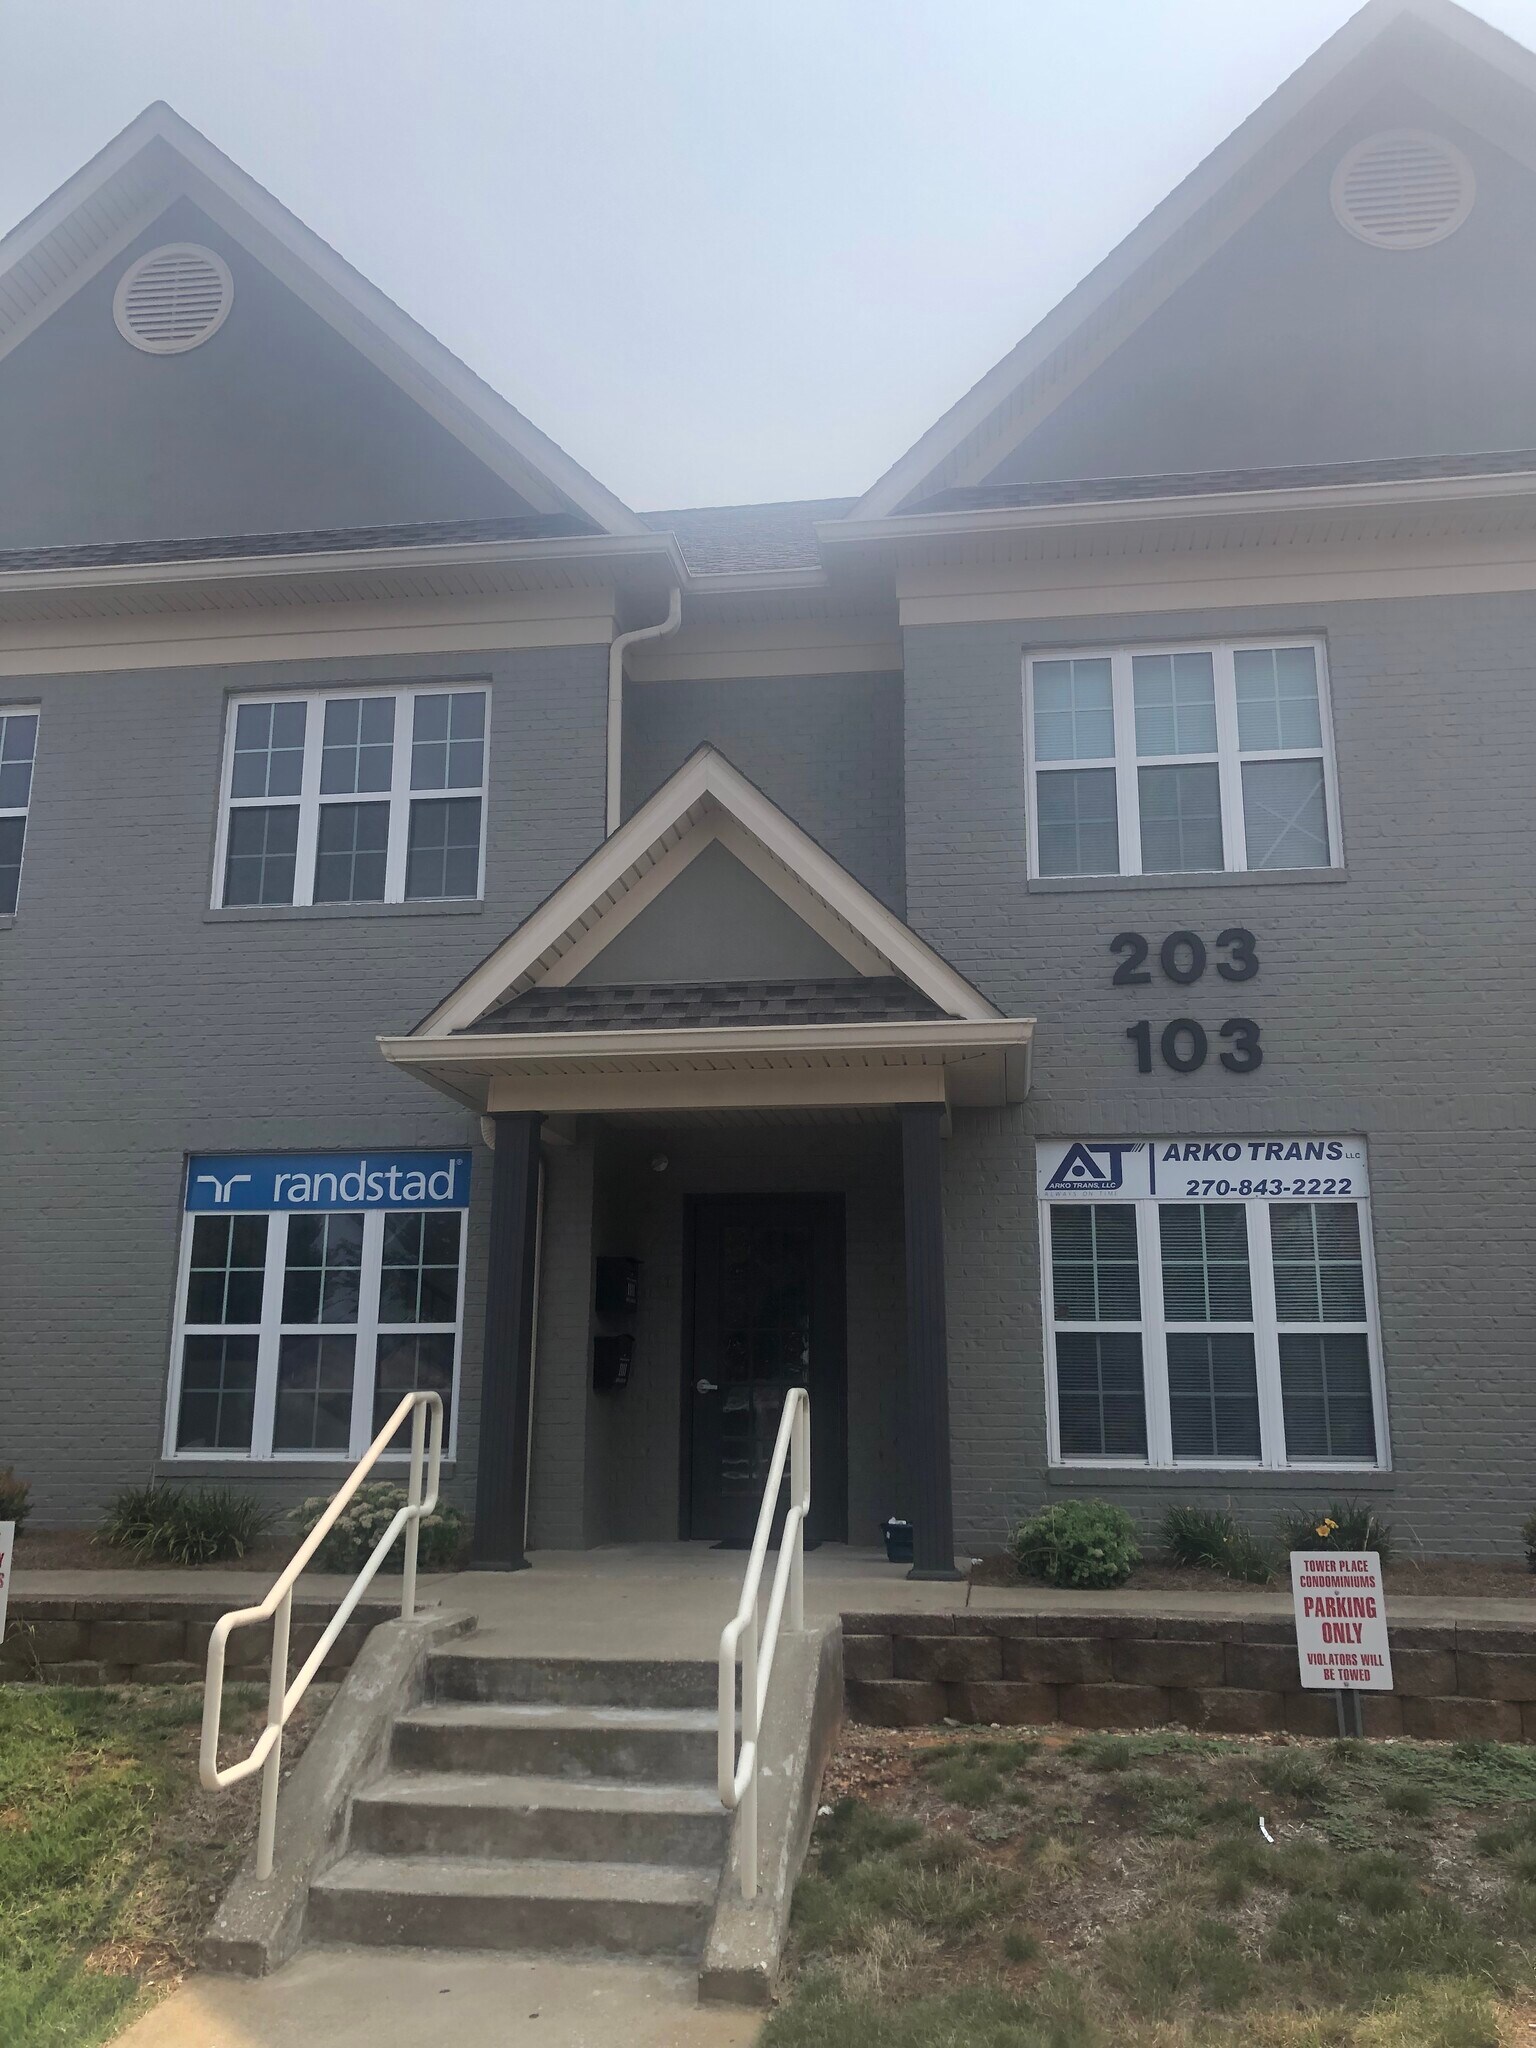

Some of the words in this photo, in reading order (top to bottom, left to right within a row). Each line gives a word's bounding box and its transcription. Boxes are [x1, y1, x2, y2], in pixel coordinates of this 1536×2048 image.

[1109, 927, 1259, 986] 203
[1126, 1017, 1263, 1073] 103
[1162, 1142, 1242, 1162] ARKO
[1248, 1141, 1343, 1161] TRANS
[273, 1158, 455, 1202] randstad
[1072, 1182, 1101, 1190] TRANS,
[1186, 1178, 1352, 1196] 270-843-2222
[1303, 1560, 1337, 1572] TOWER
[1339, 1560, 1369, 1572] PLACE
[1300, 1575, 1376, 1588] CONDOMINIUMS
[1303, 1596, 1378, 1618] PARKING
[1321, 1622, 1363, 1644] ONLY
[1307, 1653, 1358, 1666] VIOLATORS
[1360, 1654, 1385, 1666] WILL
[1323, 1668, 1336, 1681] BE
[1338, 1669, 1371, 1681] TOWED
